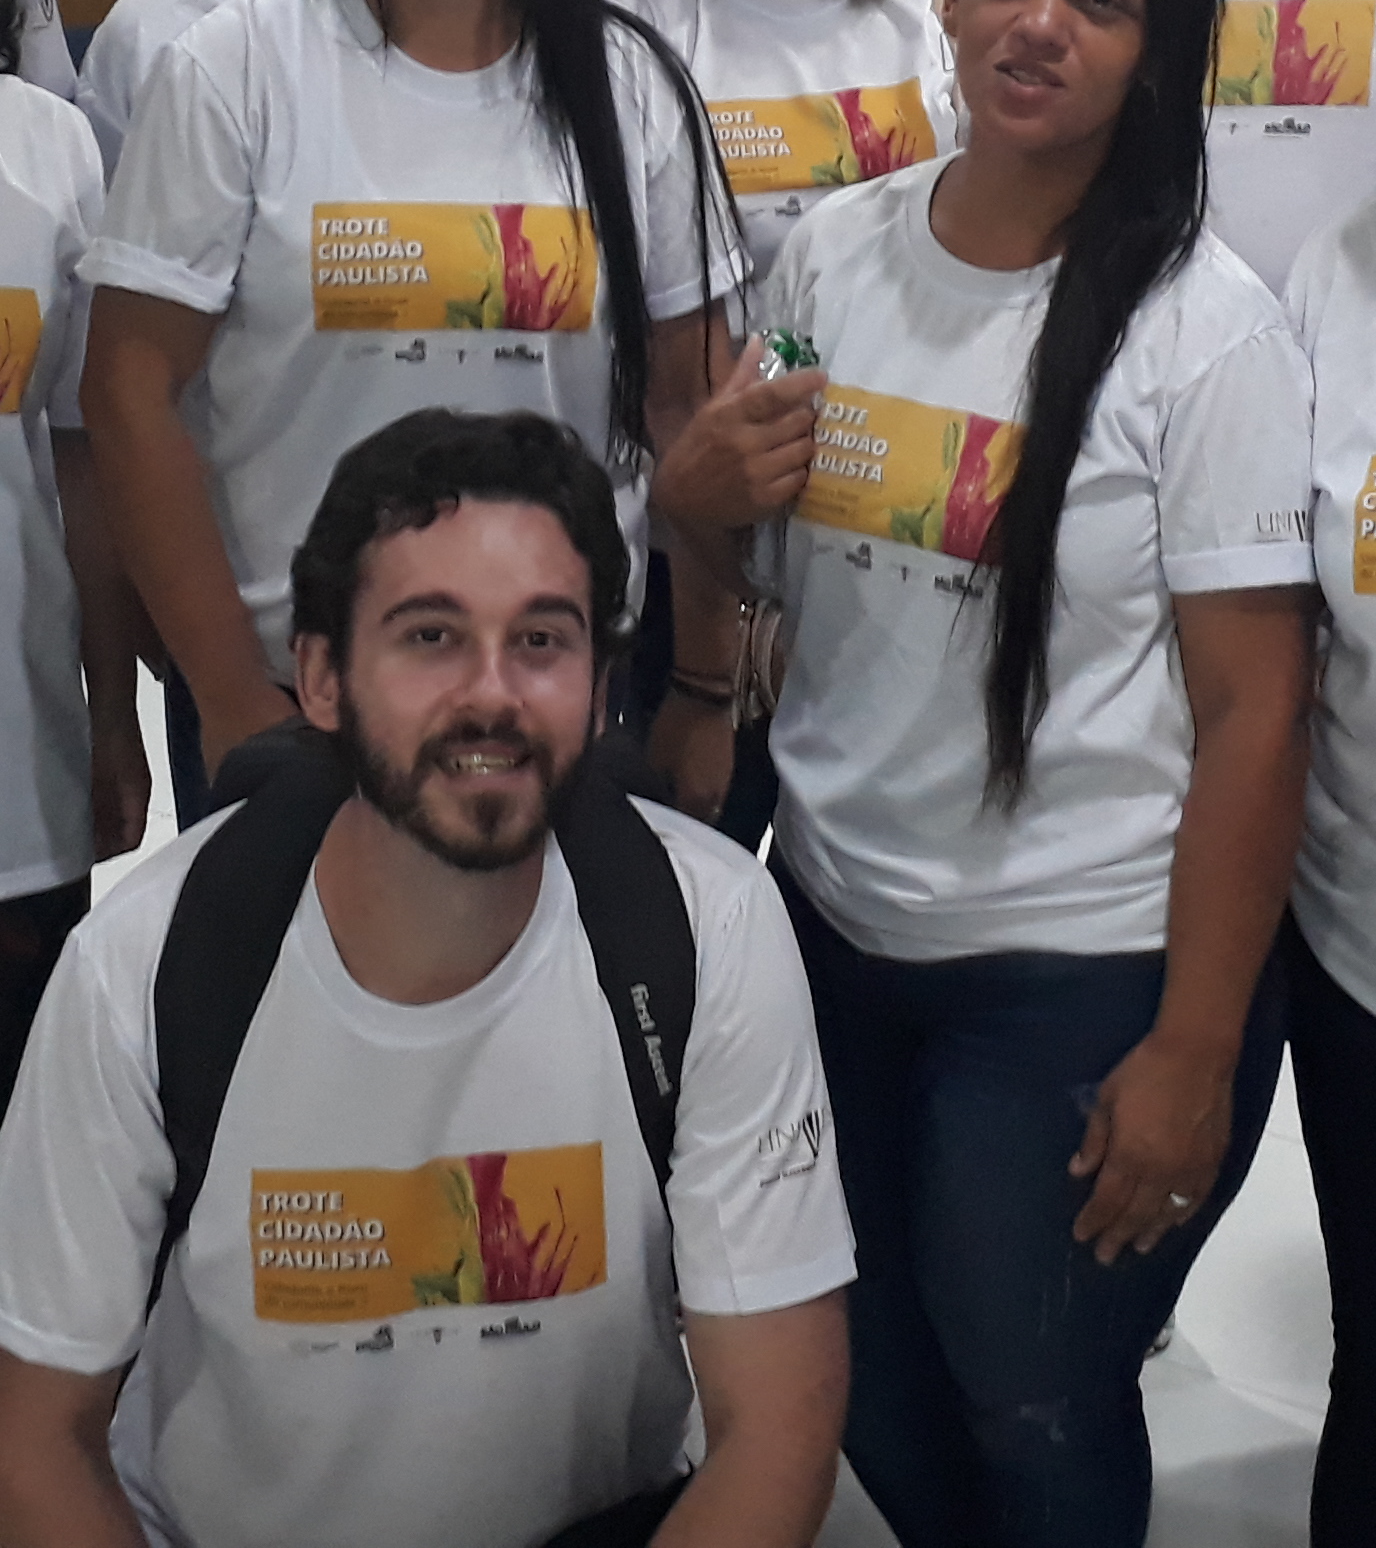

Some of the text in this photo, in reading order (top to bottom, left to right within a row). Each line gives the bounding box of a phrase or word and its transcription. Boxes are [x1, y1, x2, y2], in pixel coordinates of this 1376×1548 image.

[318, 217, 389, 237] TROTE
[318, 237, 424, 261] CIDADÃO
[318, 265, 430, 285] PAULISTA
[259, 1190, 344, 1213] TROTE
[259, 1215, 386, 1242] CIDADÃO
[260, 1248, 392, 1271] PAULISTA
